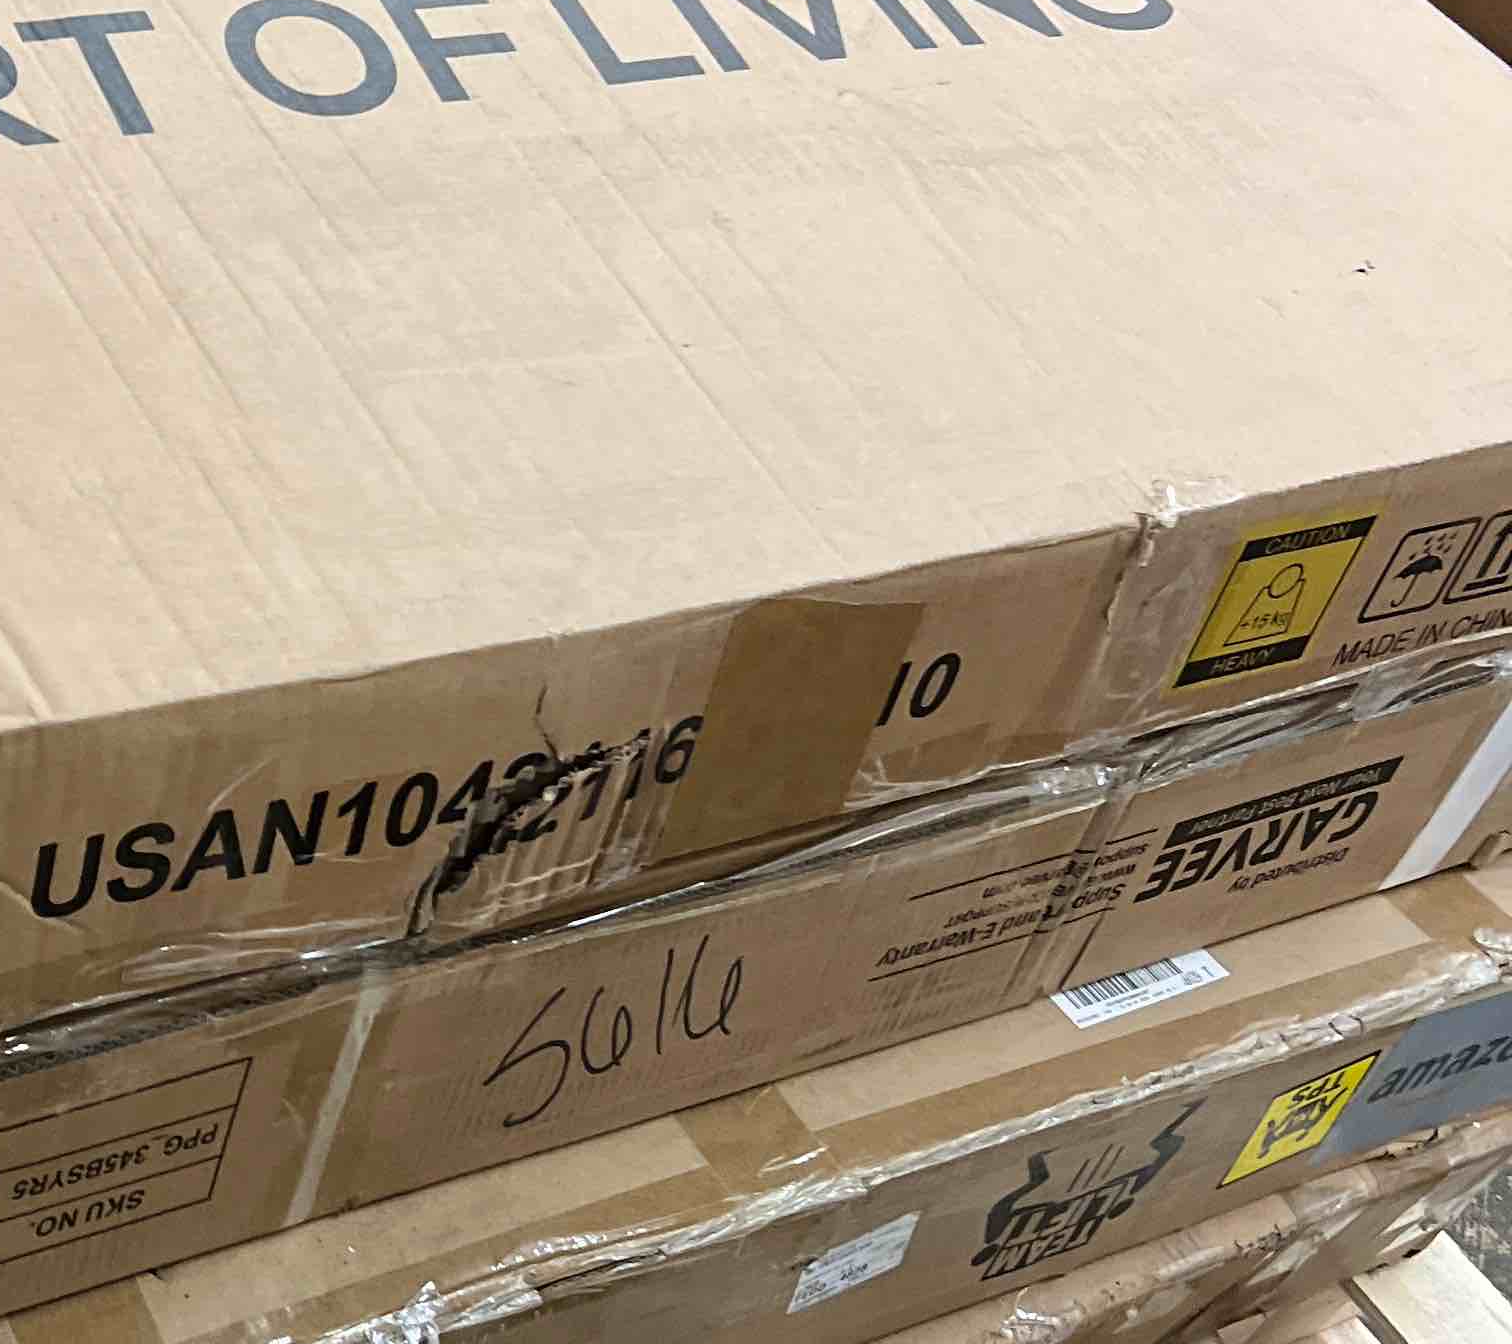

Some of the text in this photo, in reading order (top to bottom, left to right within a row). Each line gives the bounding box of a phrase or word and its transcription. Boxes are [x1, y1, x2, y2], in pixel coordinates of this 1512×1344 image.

[1265, 524, 1352, 554] CAUTION
[1210, 647, 1275, 674] HEAVY
[1332, 628, 1414, 668] MADE
[1416, 620, 1447, 647] IN
[1133, 791, 1379, 903] GARVEE
[875, 922, 997, 968] E-Warranty
[33, 1190, 146, 1239] SKU NO.
[988, 1174, 1138, 1276] TEAM LIFT
